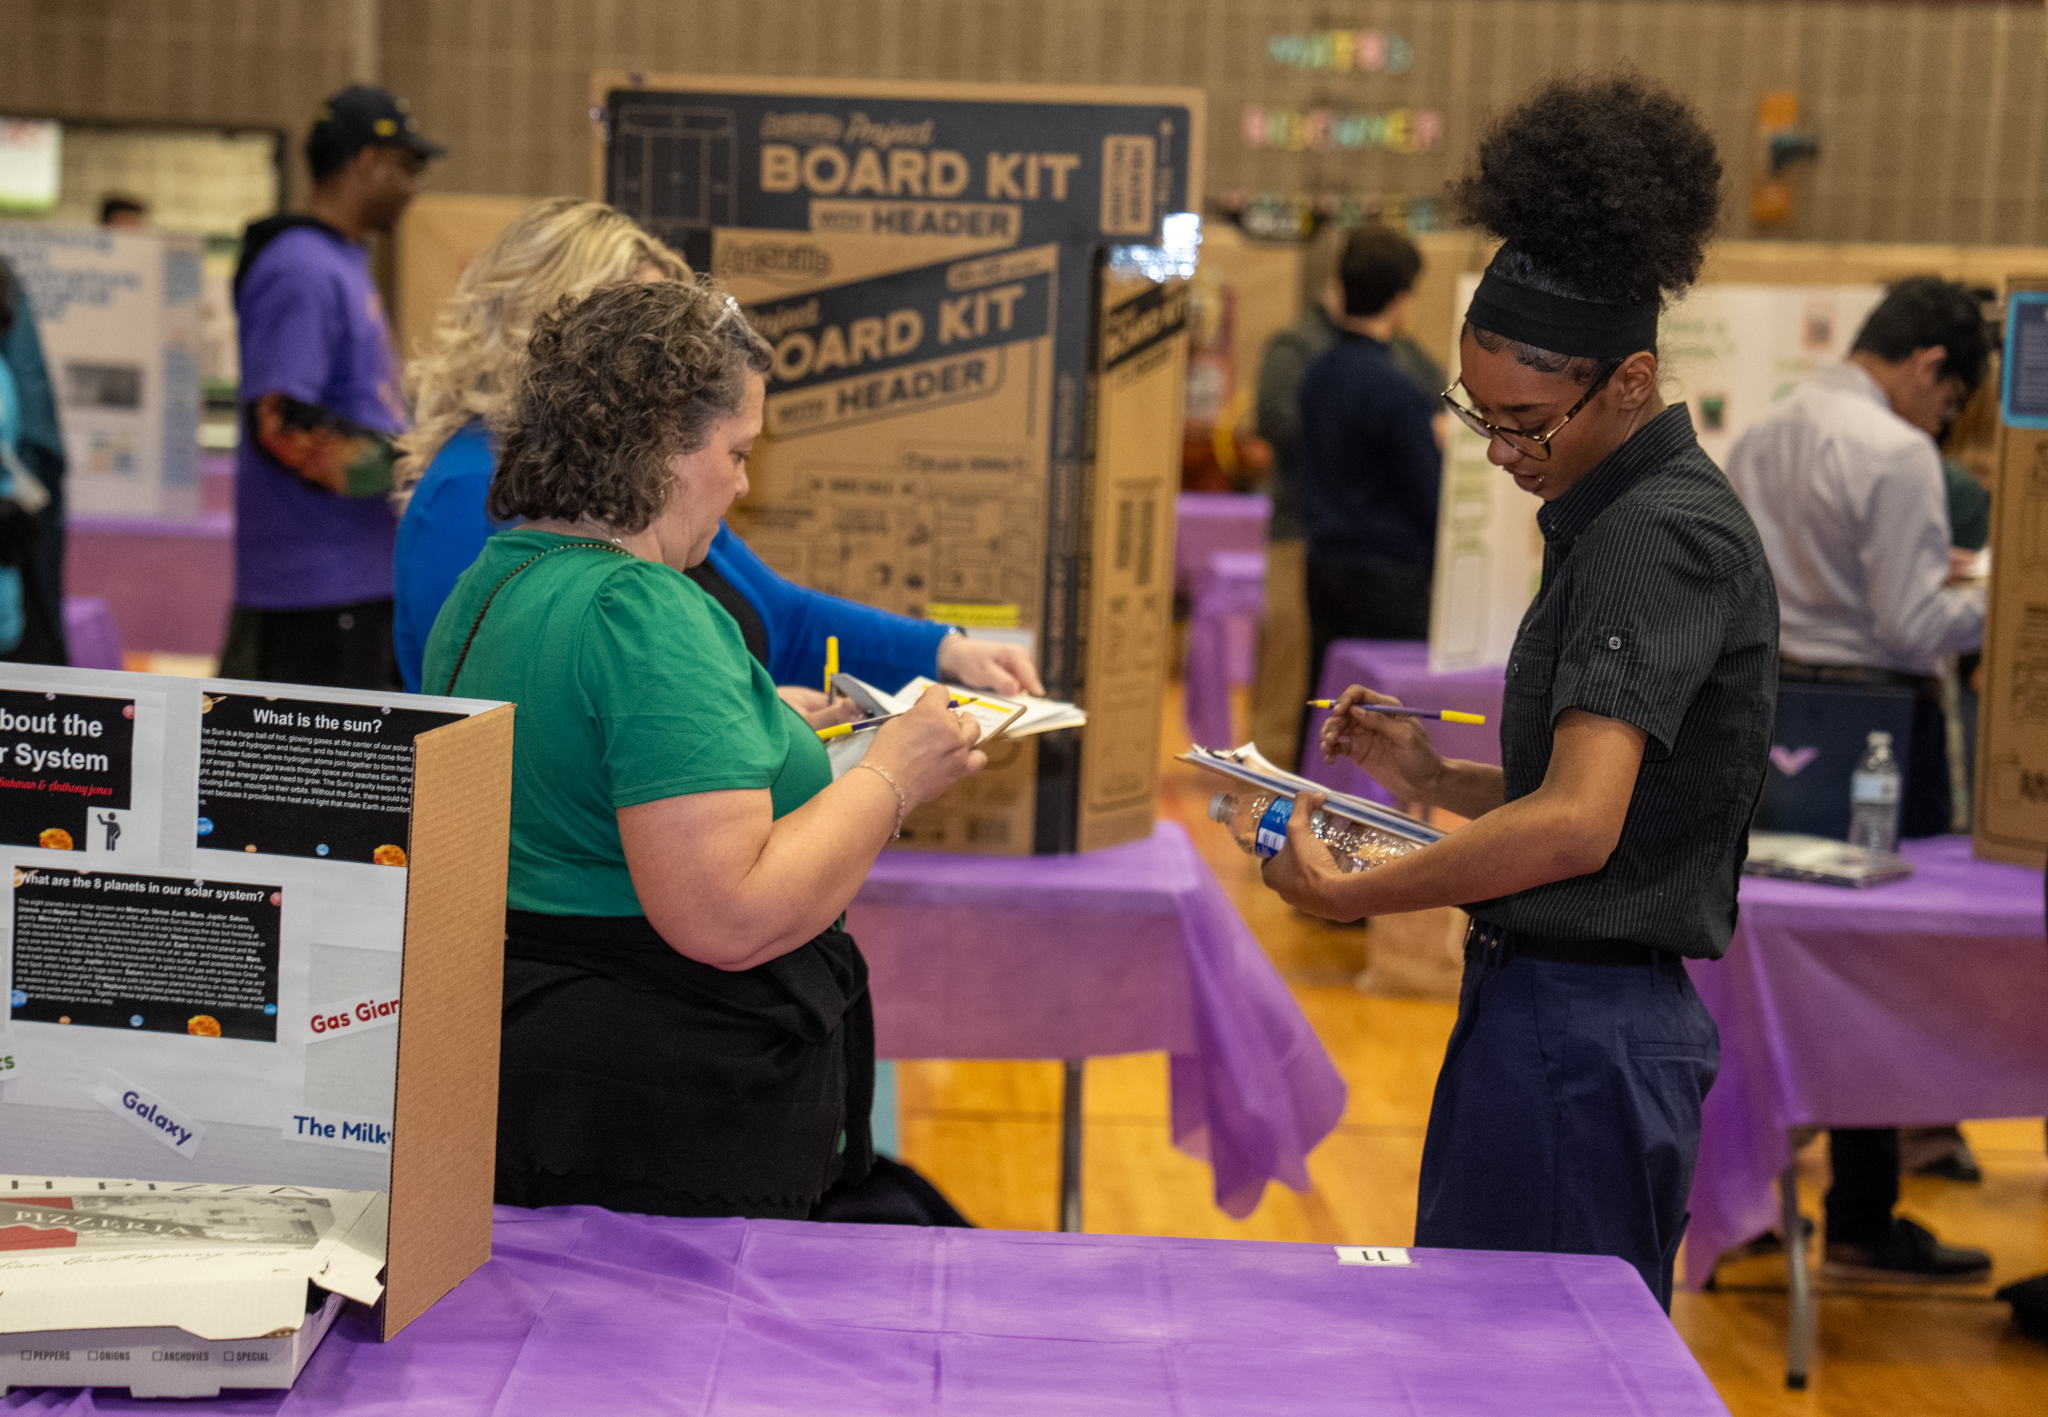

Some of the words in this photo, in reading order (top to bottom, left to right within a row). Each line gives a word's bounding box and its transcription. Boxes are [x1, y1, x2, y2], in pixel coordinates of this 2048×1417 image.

[760, 144, 969, 196] BOARD
[987, 152, 1080, 199] KIT
[871, 208, 1011, 238] HEADER
[771, 308, 924, 382] OARD
[938, 282, 1026, 345] KIT
[837, 361, 985, 415] HEADER
[0, 708, 57, 735] bout
[63, 713, 103, 738] the
[253, 708, 294, 726] What
[297, 712, 311, 728] is
[315, 714, 340, 730] the
[343, 719, 382, 733] sun?
[211, 728, 224, 737] Sun
[238, 730, 253, 741] huge
[255, 732, 266, 741] ball
[288, 734, 312, 746] glowing
[313, 738, 332, 748] gases
[341, 739, 351, 748] the
[352, 740, 371, 750] center
[381, 744, 391, 752] our
[392, 744, 408, 753] solar
[219, 739, 236, 748] made
[246, 741, 274, 753] hydrogen
[276, 744, 287, 753] and
[313, 747, 325, 756] and
[335, 749, 348, 758] heat
[350, 750, 362, 759] and
[363, 751, 376, 762] light
[378, 754, 394, 762] come
[396, 754, 411, 764] from
[15, 742, 109, 772] System
[217, 748, 239, 759] nuclear
[263, 752, 282, 762] where
[283, 754, 312, 767] hydrogen
[314, 757, 332, 767] atoms
[334, 759, 345, 770] join
[346, 760, 372, 772] together
[381, 763, 395, 772] form
[212, 768, 223, 777] and
[225, 769, 235, 778] the
[236, 772, 257, 782] energy
[259, 772, 278, 784] plants
[280, 774, 295, 784] need
[322, 778, 334, 787] The
[336, 779, 353, 789] Sun's
[354, 781, 375, 792] gravity
[376, 783, 395, 794] keeps
[397, 784, 406, 793] the
[237, 760, 250, 769] This
[252, 763, 273, 773] energy
[275, 763, 295, 773] travels
[297, 765, 320, 777] through
[322, 769, 340, 779] space
[341, 769, 353, 778] and
[355, 770, 379, 781] reaches
[38, 780, 46, 790] &
[48, 781, 88, 796] Anthony
[87, 784, 113, 797] jones
[215, 788, 241, 799] because
[248, 791, 274, 803] provides
[276, 794, 285, 803] the
[287, 795, 301, 804] heat
[302, 796, 314, 805] and
[316, 797, 328, 808] light
[330, 798, 342, 808] that
[343, 799, 360, 809] make
[362, 801, 378, 811] Earth
[244, 781, 266, 793] moving
[275, 784, 289, 793] their
[311, 787, 334, 797] Without
[336, 789, 346, 798] the
[363, 791, 379, 801] there
[380, 793, 399, 803] would
[22, 873, 50, 885] What
[51, 877, 71, 887] are
[72, 877, 91, 889] the
[94, 878, 102, 888] 8
[103, 879, 146, 893] planets
[148, 882, 160, 893] in
[162, 886, 182, 896] our
[184, 886, 214, 897] solar
[215, 891, 265, 902] system?
[310, 1013, 351, 1033] Gas
[122, 1091, 192, 1146] Galaxy
[293, 1115, 336, 1138] The
[15, 1210, 192, 1235] PIZZERIA
[33, 1351, 70, 1361] PEPPERS
[100, 1351, 130, 1361] ONIONS
[163, 1351, 209, 1361] ANCHOVIES
[236, 1351, 269, 1361] SPECIAL
